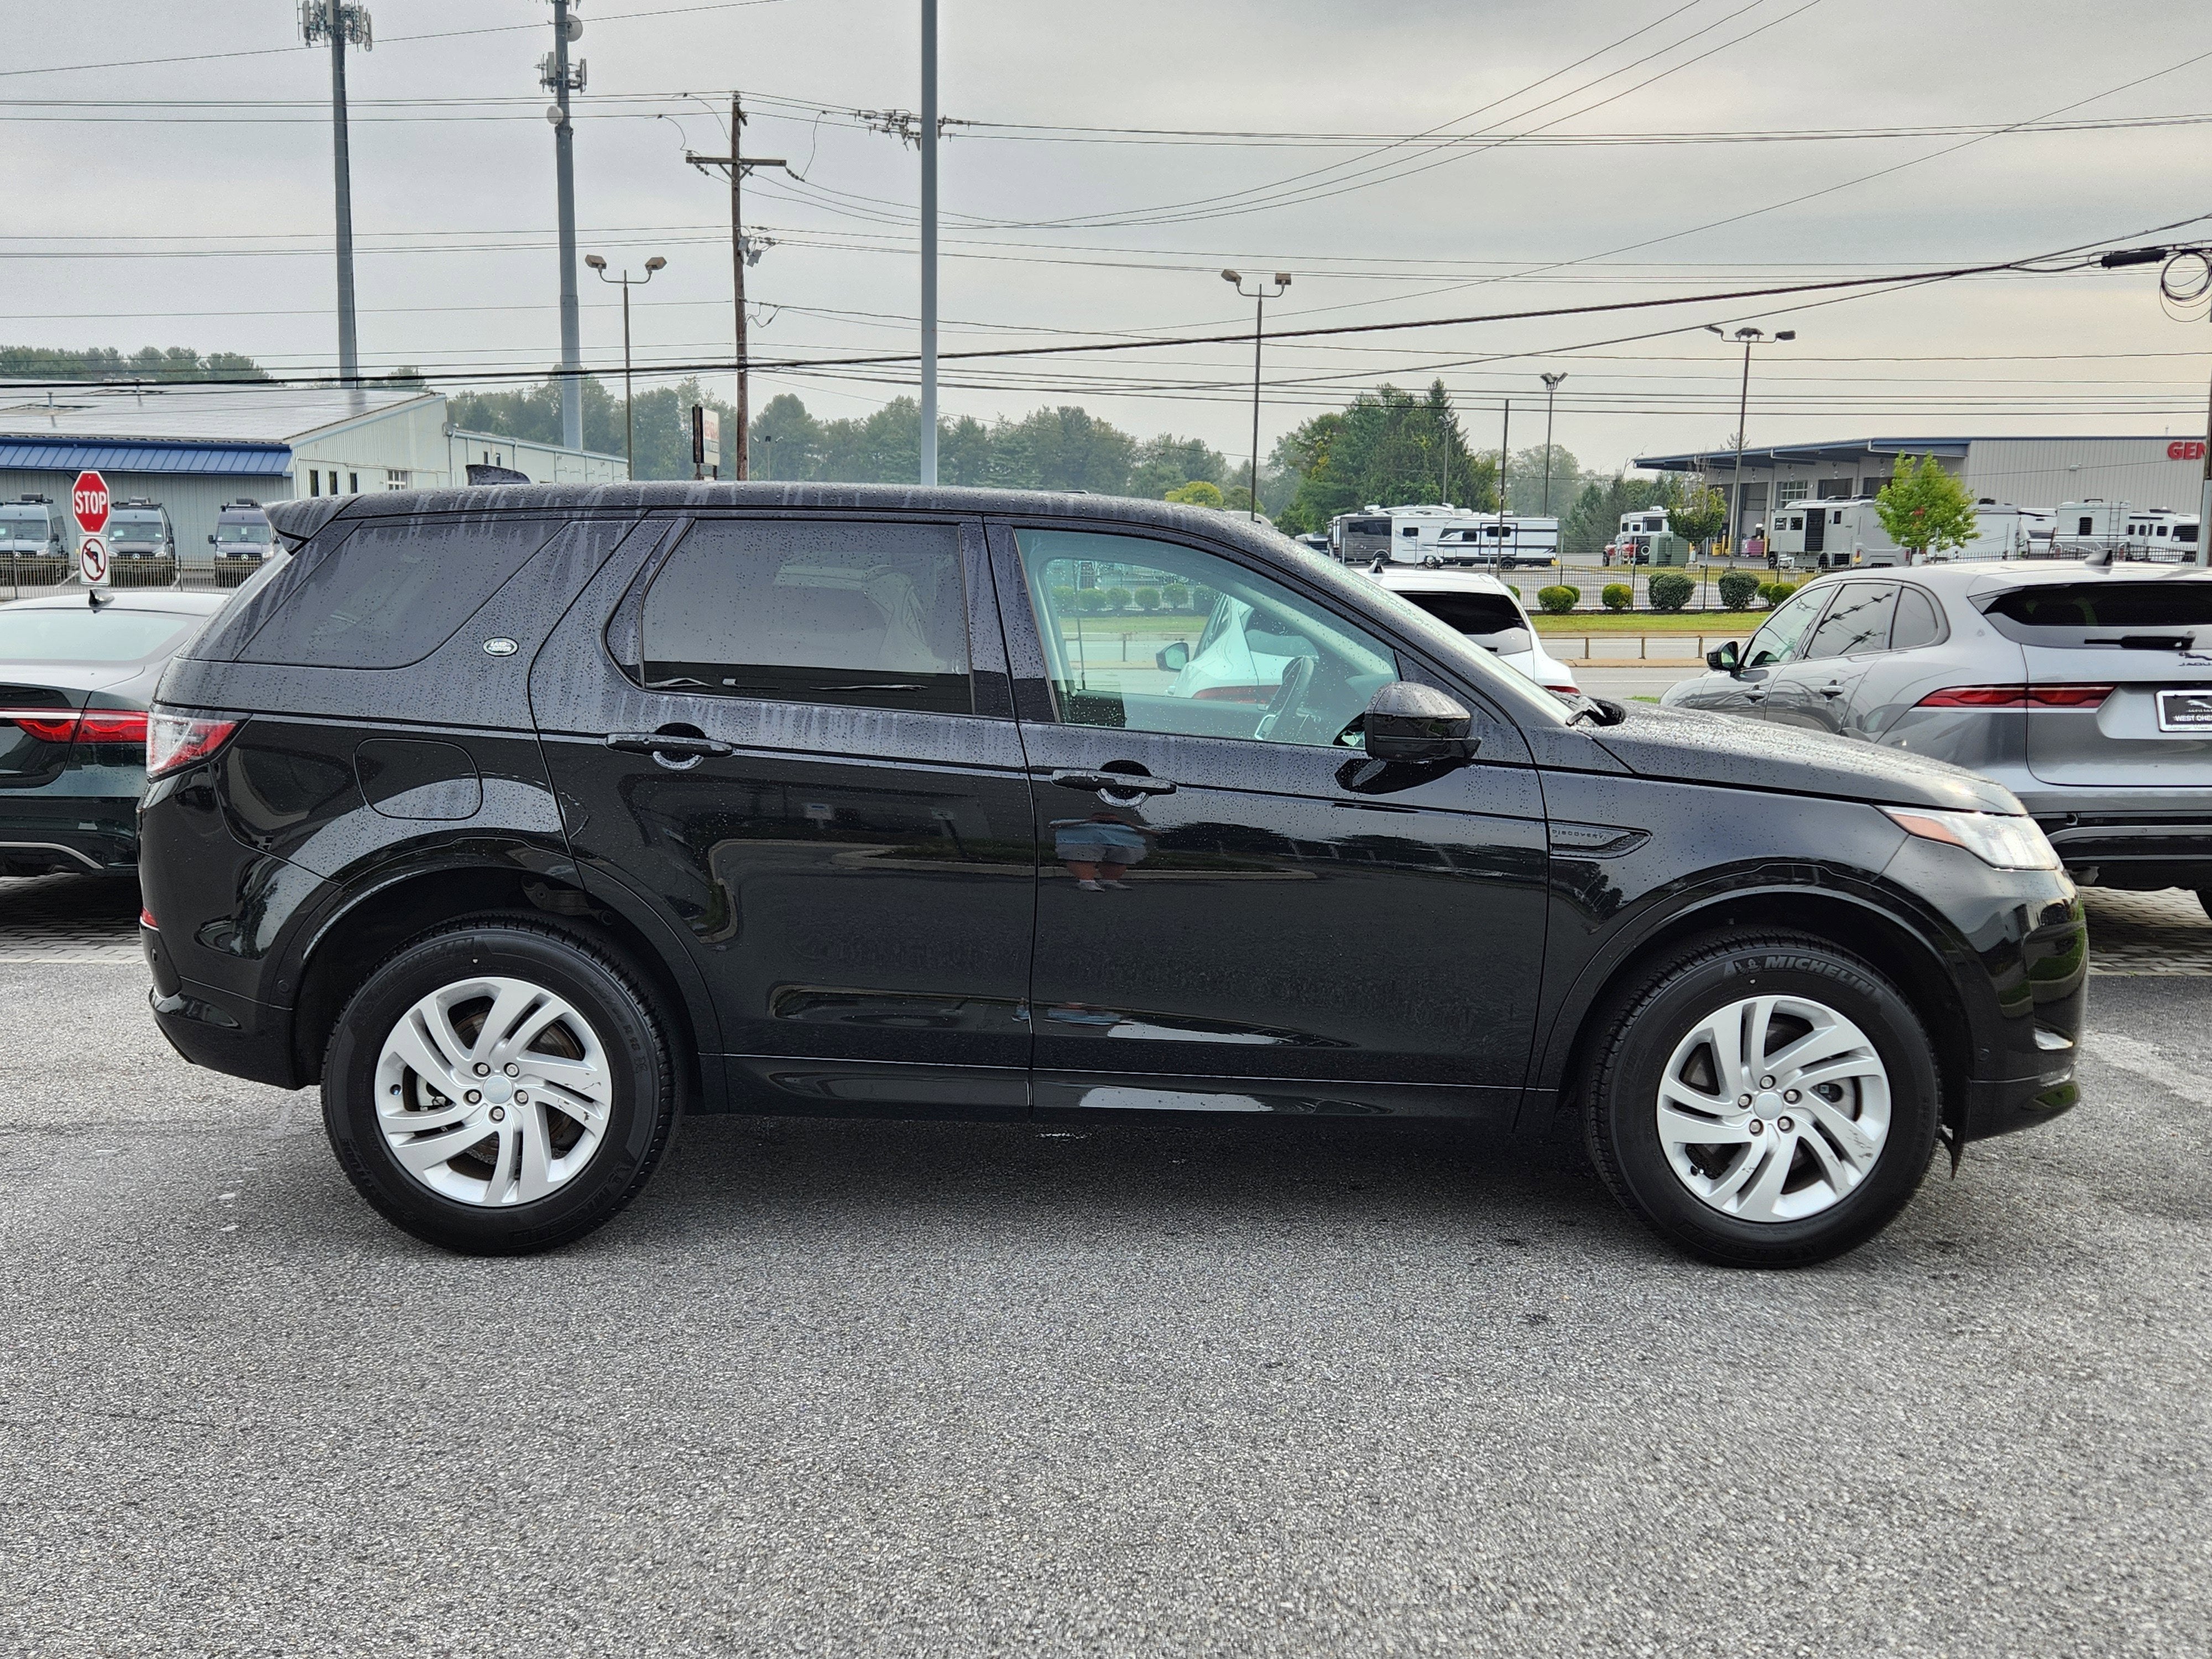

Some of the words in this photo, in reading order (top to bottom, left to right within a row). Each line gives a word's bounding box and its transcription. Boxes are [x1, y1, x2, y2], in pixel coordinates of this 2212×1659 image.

[75, 491, 107, 514] STOP
[1552, 830, 1604, 839] DISCOVERY
[1764, 956, 1876, 995] MICHELIN
